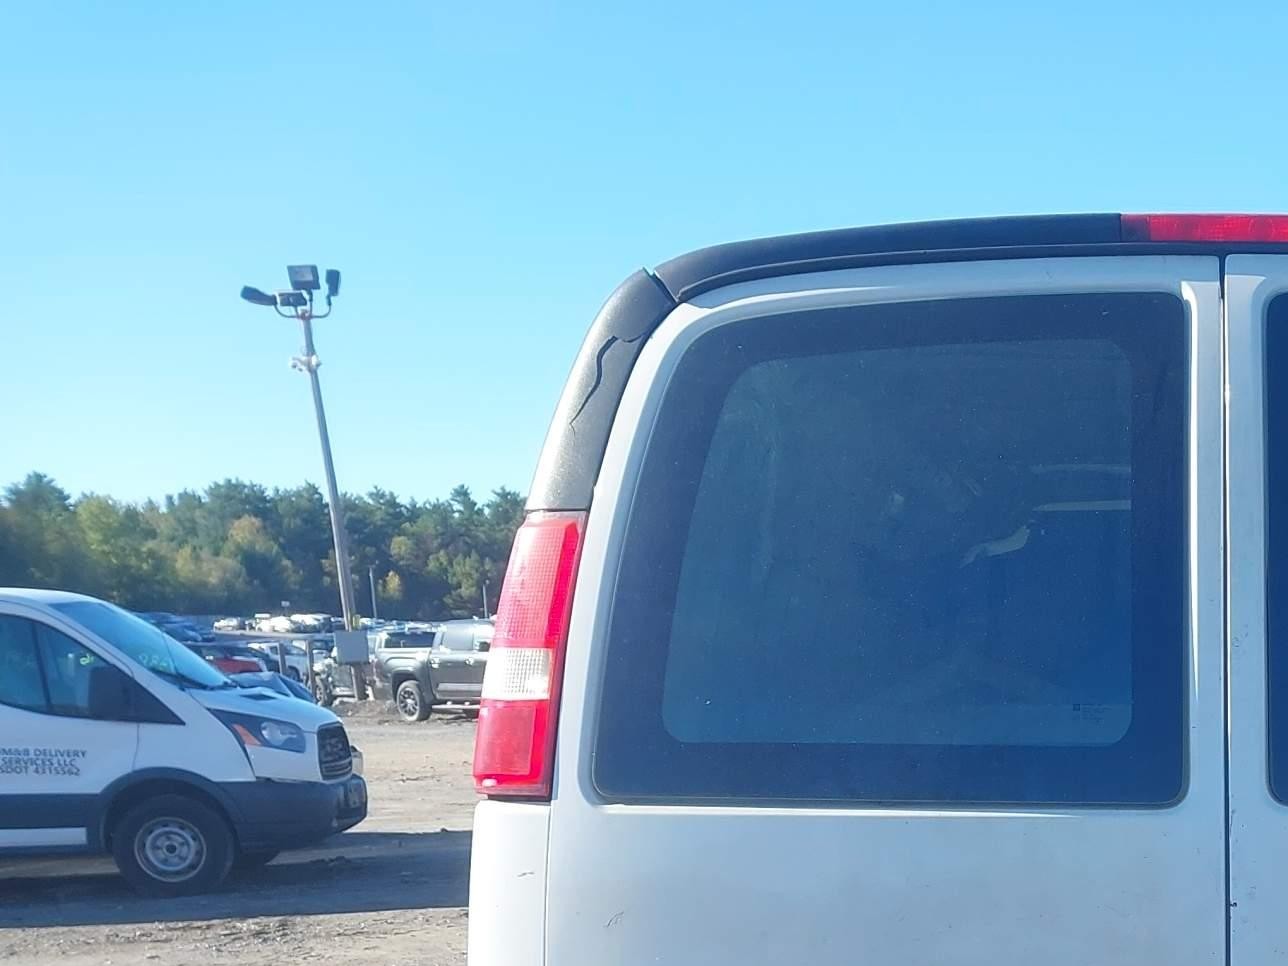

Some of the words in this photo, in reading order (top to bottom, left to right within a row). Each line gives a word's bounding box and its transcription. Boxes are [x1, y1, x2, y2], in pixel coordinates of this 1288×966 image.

[33, 748, 87, 758] DELIVERY
[1, 757, 54, 767] SERVICES
[57, 758, 76, 767] LLC
